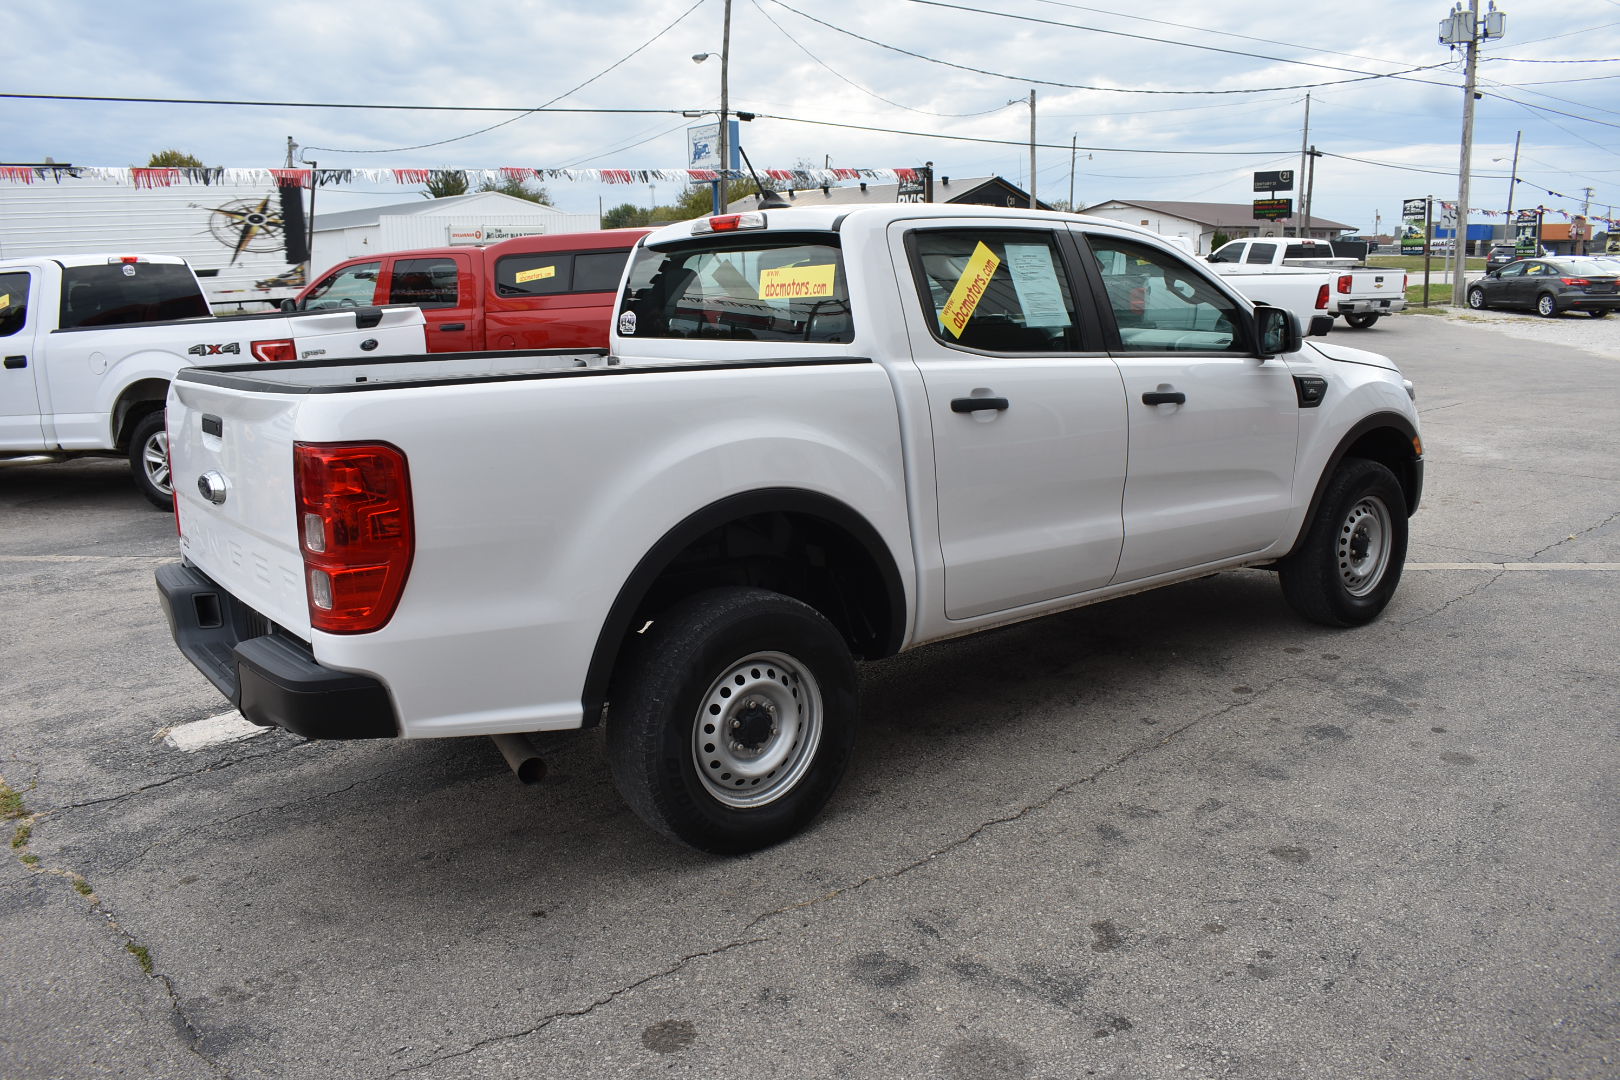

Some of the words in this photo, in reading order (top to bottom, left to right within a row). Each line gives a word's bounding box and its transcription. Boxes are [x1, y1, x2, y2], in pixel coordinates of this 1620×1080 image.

[1282, 171, 1290, 179] 21
[765, 279, 826, 296] abcmotors.com
[954, 259, 995, 328] abcmotors.com
